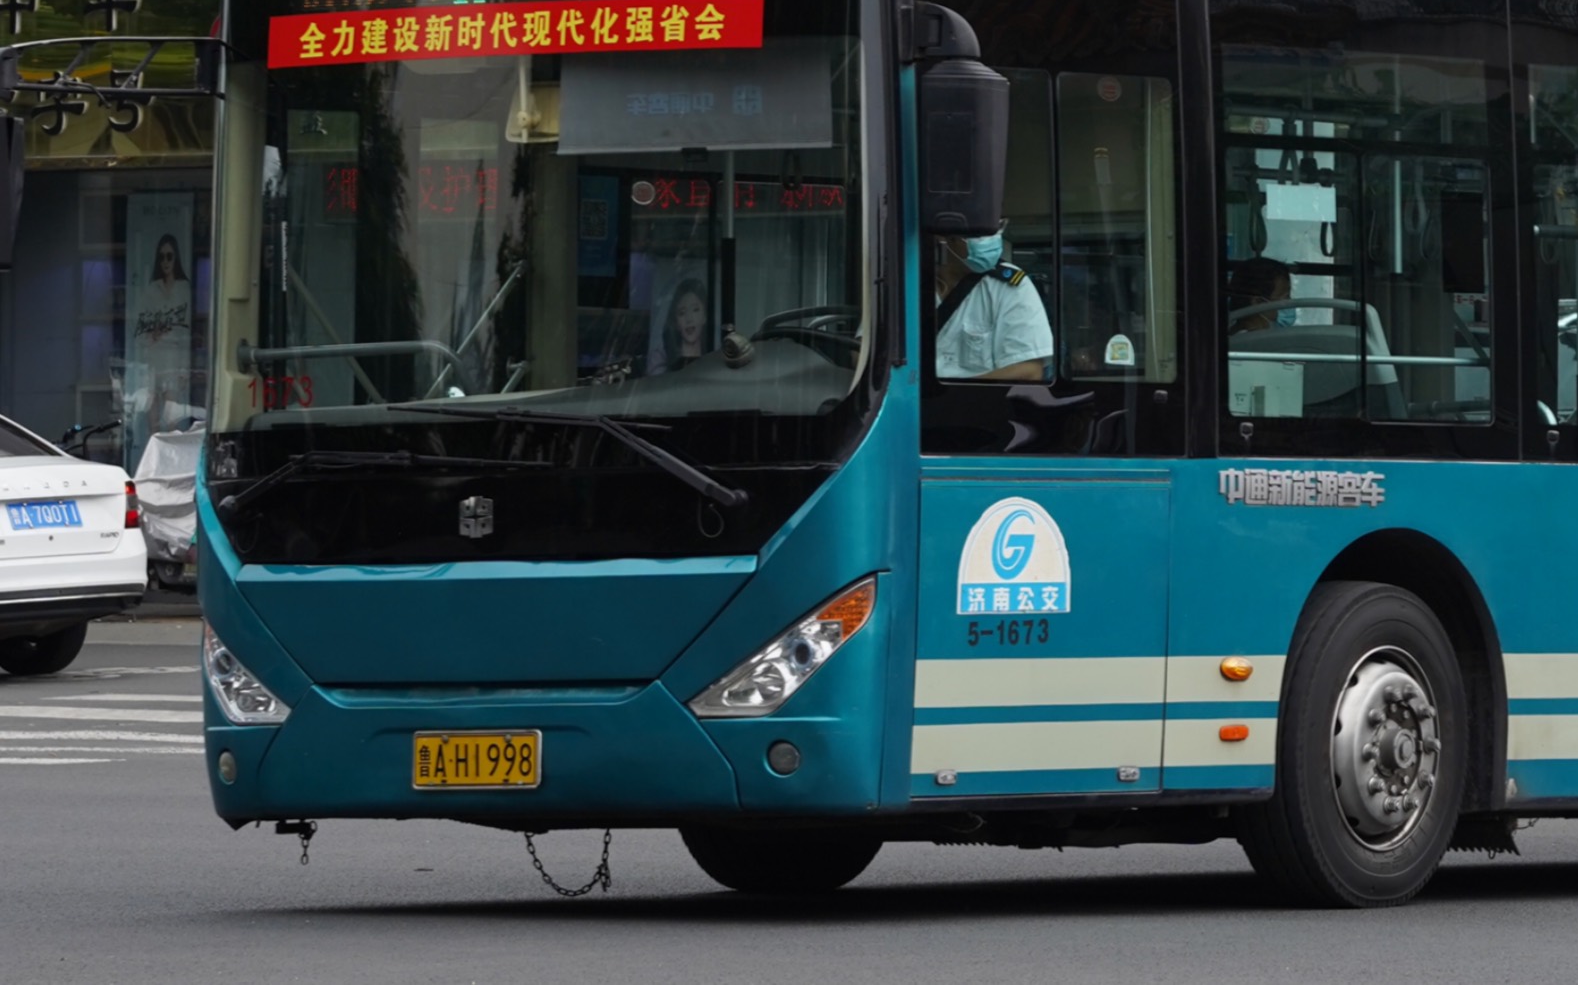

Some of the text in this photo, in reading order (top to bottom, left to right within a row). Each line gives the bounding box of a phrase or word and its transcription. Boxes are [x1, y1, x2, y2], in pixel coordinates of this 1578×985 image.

[299, 2, 727, 59] 全力建设新时代现代化强省会
[0, 70, 157, 136] 字号
[247, 375, 314, 409] 1673
[1218, 467, 1386, 508] 中通新能源客车
[967, 586, 1060, 612] 济南公交
[966, 618, 1050, 647] 5-1673
